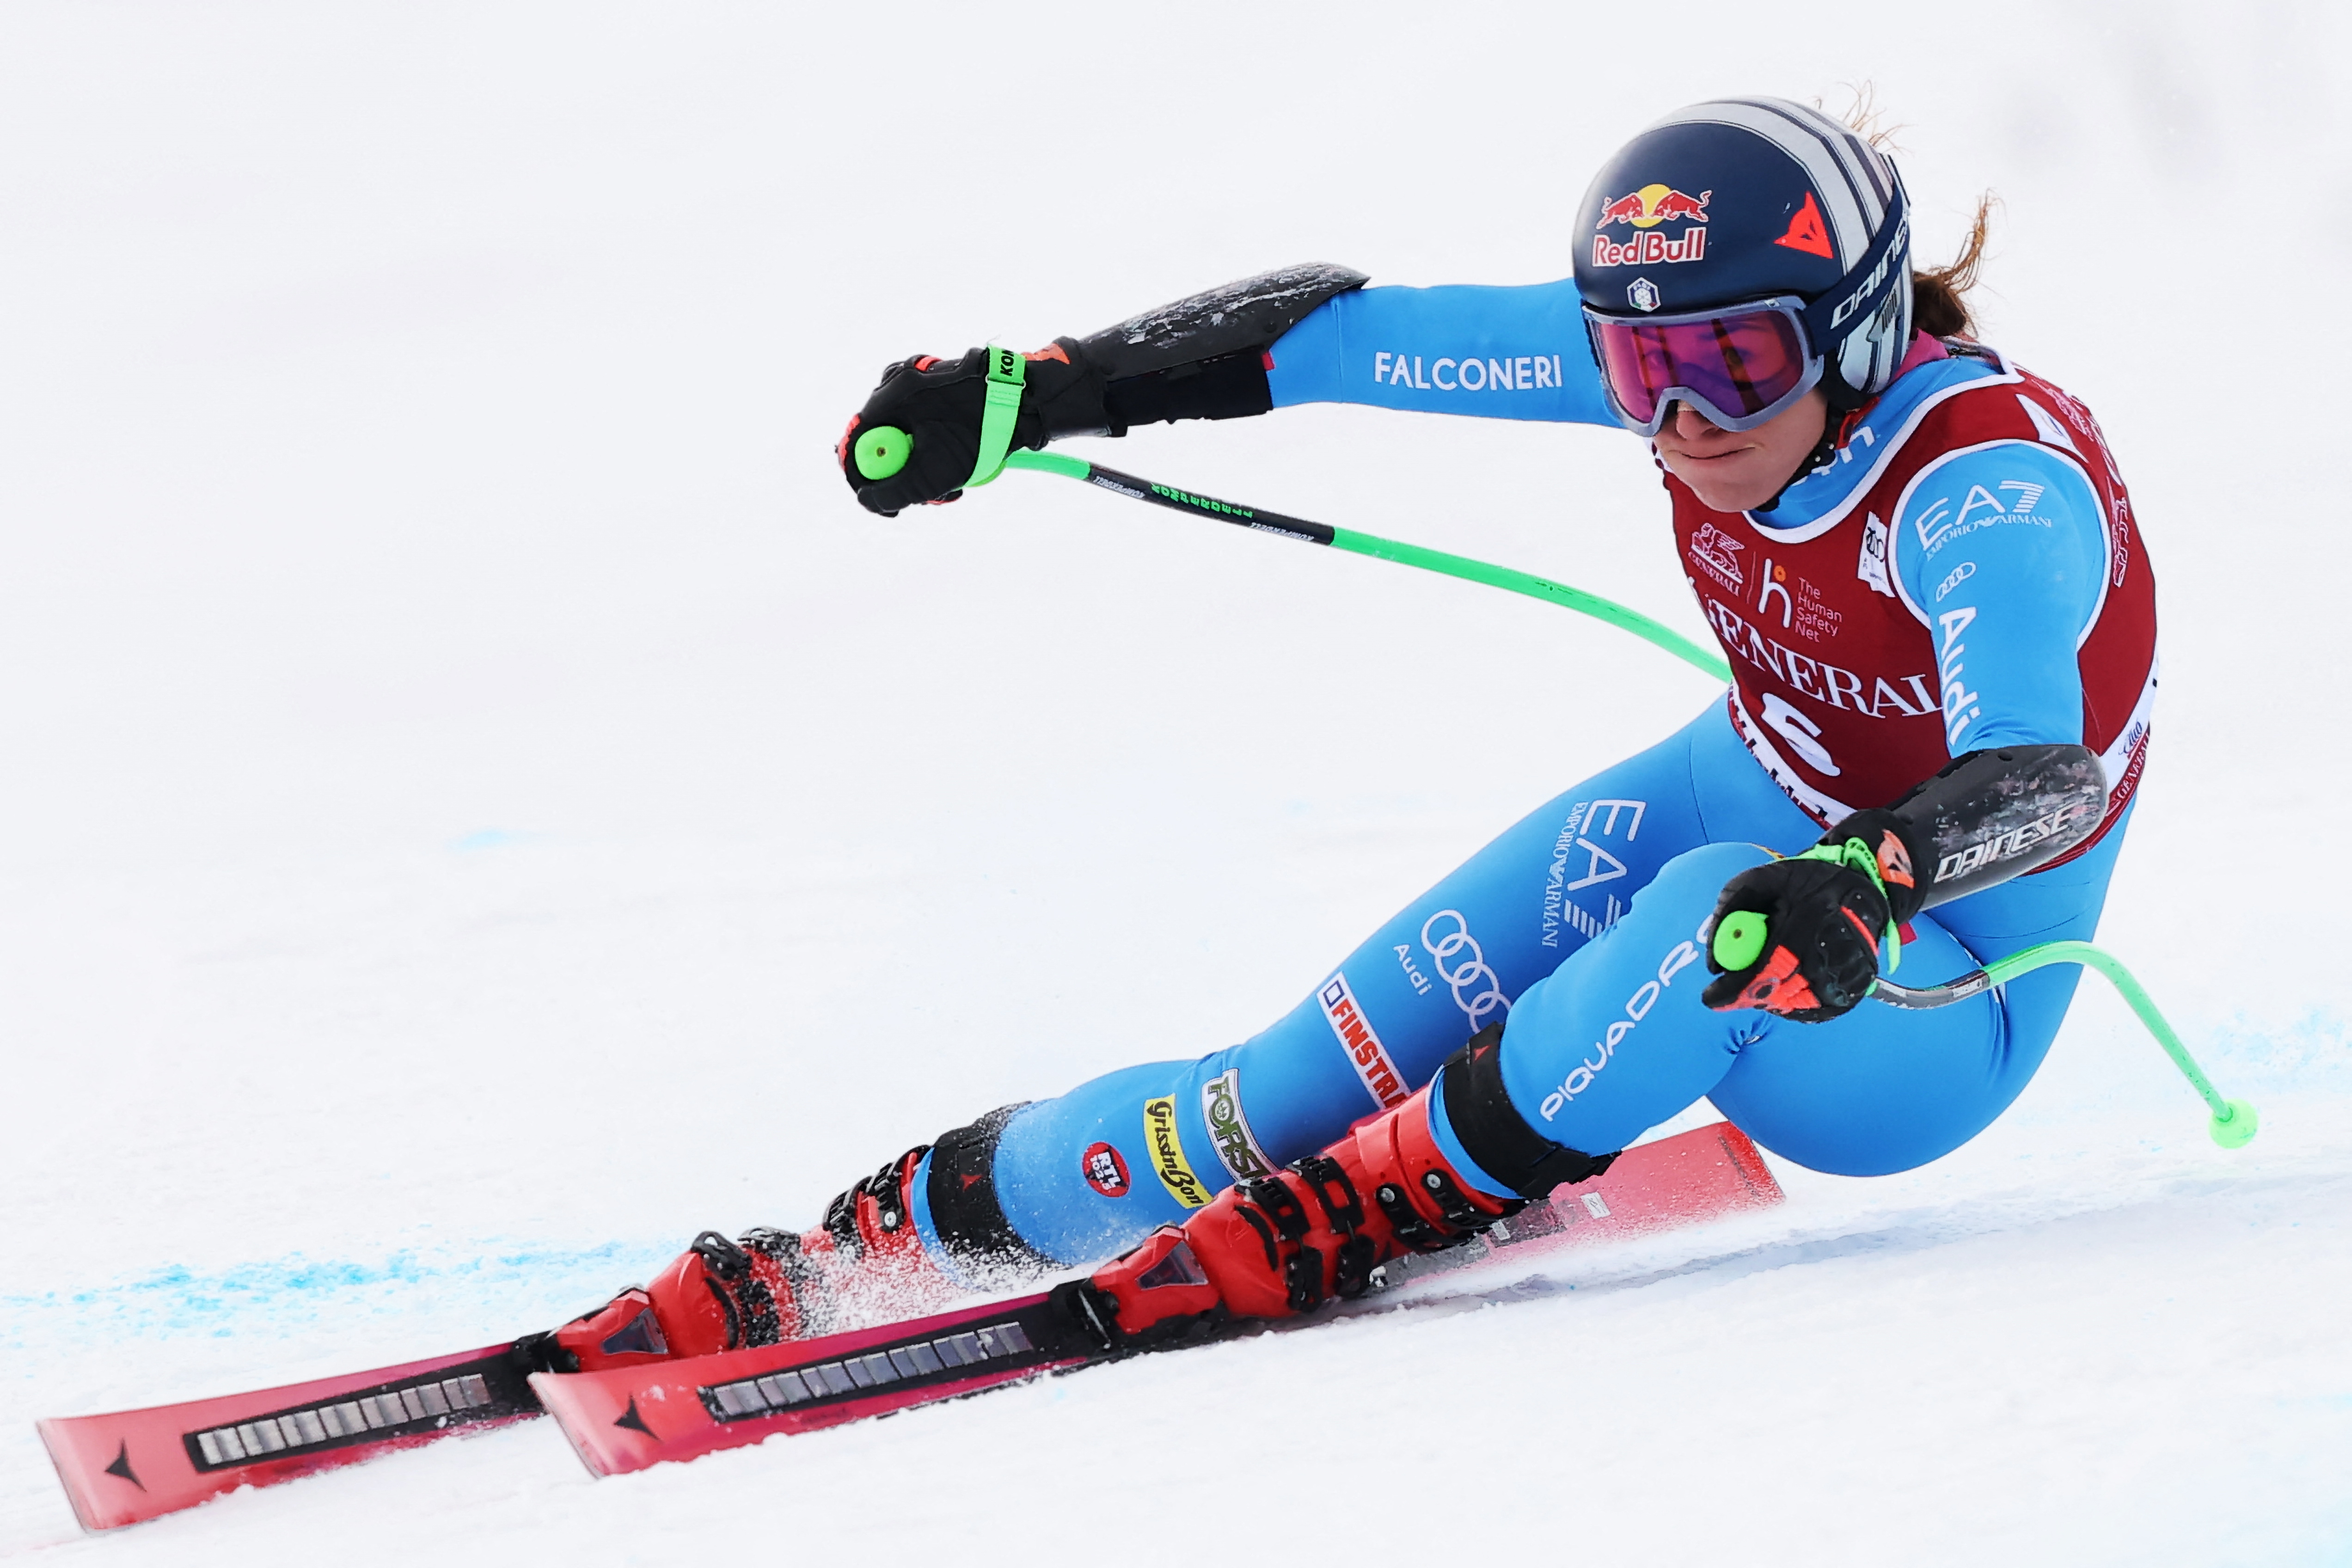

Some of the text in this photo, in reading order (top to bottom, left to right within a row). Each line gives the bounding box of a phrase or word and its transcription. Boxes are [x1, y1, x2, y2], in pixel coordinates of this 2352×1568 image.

[1592, 227, 1706, 266] Red Bull
[1830, 209, 1908, 329] DAINE
[1374, 351, 1562, 391] FALCONERI
[1151, 482, 1253, 518] KOMPERDELL
[1915, 480, 2045, 551] EA7
[1998, 514, 2052, 528] ARMANI
[1797, 591, 1843, 623] Human
[1798, 577, 1820, 599] The
[1795, 620, 1820, 643] Net
[1796, 606, 1838, 637] Safety
[1697, 587, 1943, 718] ENERAL
[1939, 606, 1981, 746] Audi
[1934, 802, 2078, 883] DAINESE
[1541, 802, 1589, 948] EMPORIO ARMANI
[1564, 799, 1647, 940] EA7
[1393, 944, 1432, 995] Audi
[1331, 998, 1407, 1109] FINSTR
[1090, 1155, 1112, 1190] 102.5
[1097, 1152, 1121, 1188] RTL
